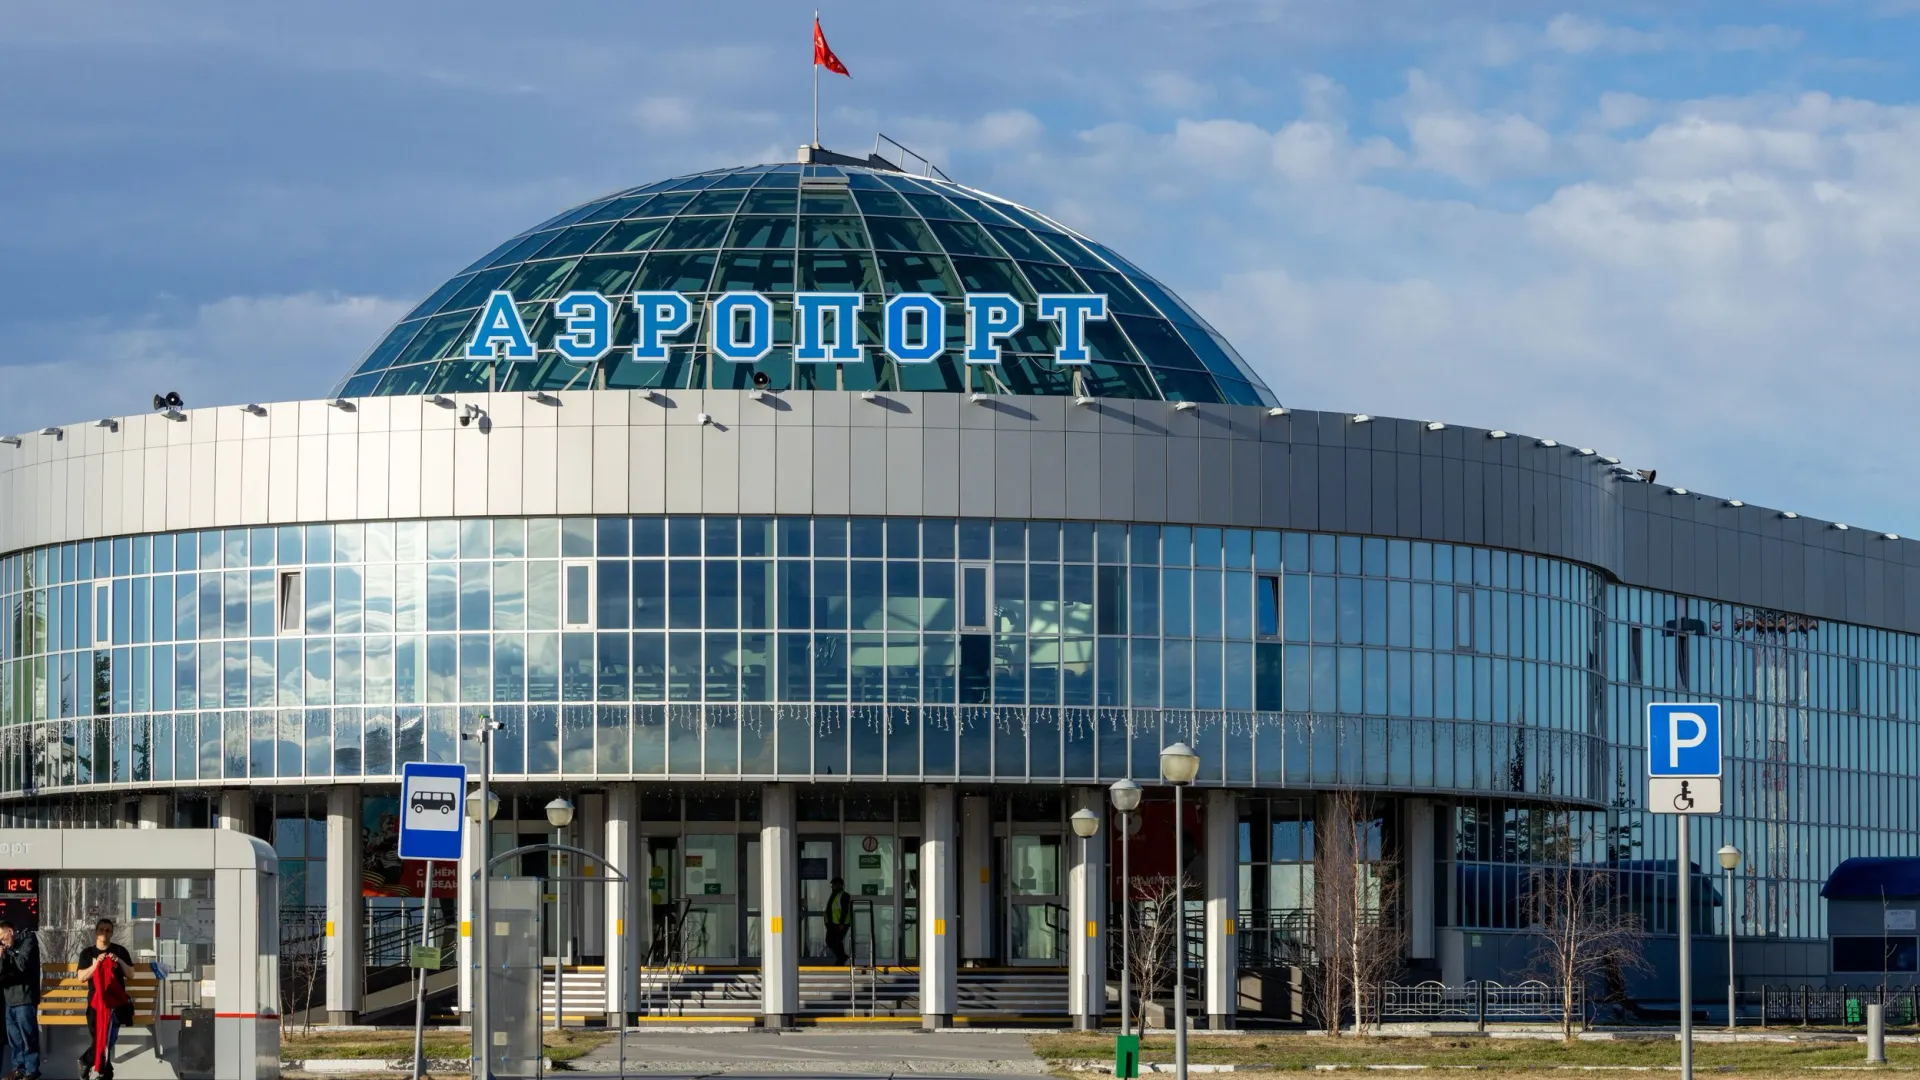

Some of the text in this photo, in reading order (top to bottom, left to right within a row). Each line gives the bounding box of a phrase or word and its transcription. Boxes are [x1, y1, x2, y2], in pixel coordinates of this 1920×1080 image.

[464, 290, 1108, 365] АЭРОПОРТ
[1669, 712, 1707, 768] P
[430, 867, 456, 877] НЁМ
